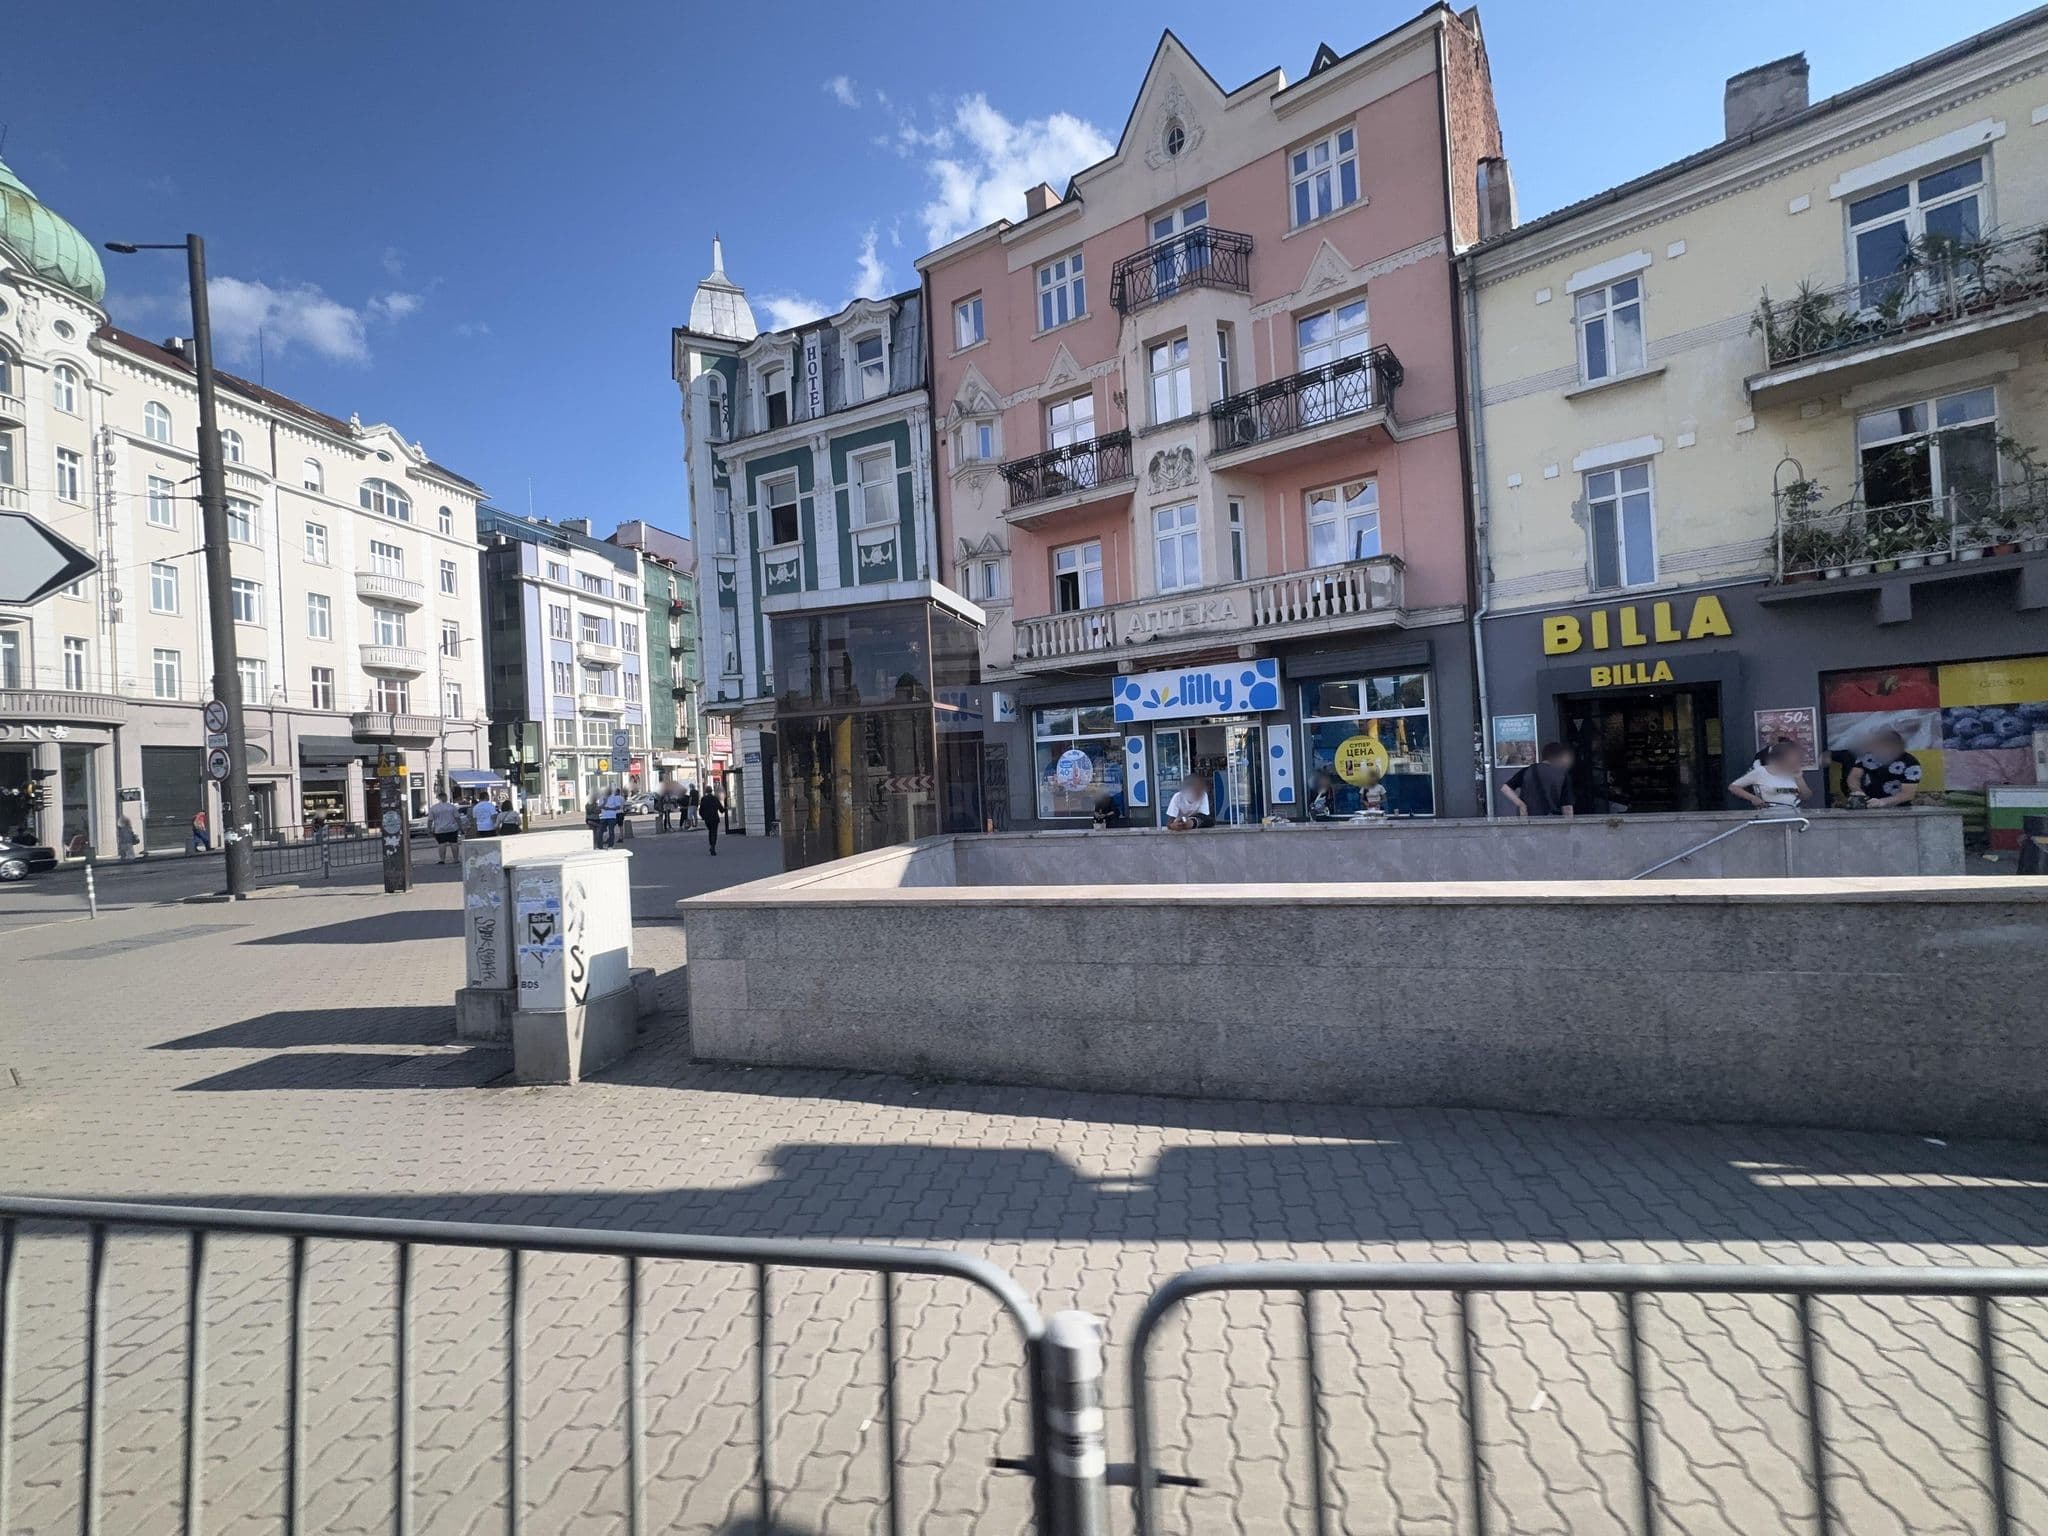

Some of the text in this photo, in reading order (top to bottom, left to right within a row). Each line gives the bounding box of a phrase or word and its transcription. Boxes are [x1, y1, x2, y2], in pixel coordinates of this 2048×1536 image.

[1127, 598, 1238, 634] АПТЕКА
[1543, 595, 1732, 655] BILLA
[1590, 660, 1674, 688] BILLA
[1179, 672, 1233, 711] lilly
[1346, 748, 1375, 757] ЦЕНА
[520, 980, 540, 989] BDS
